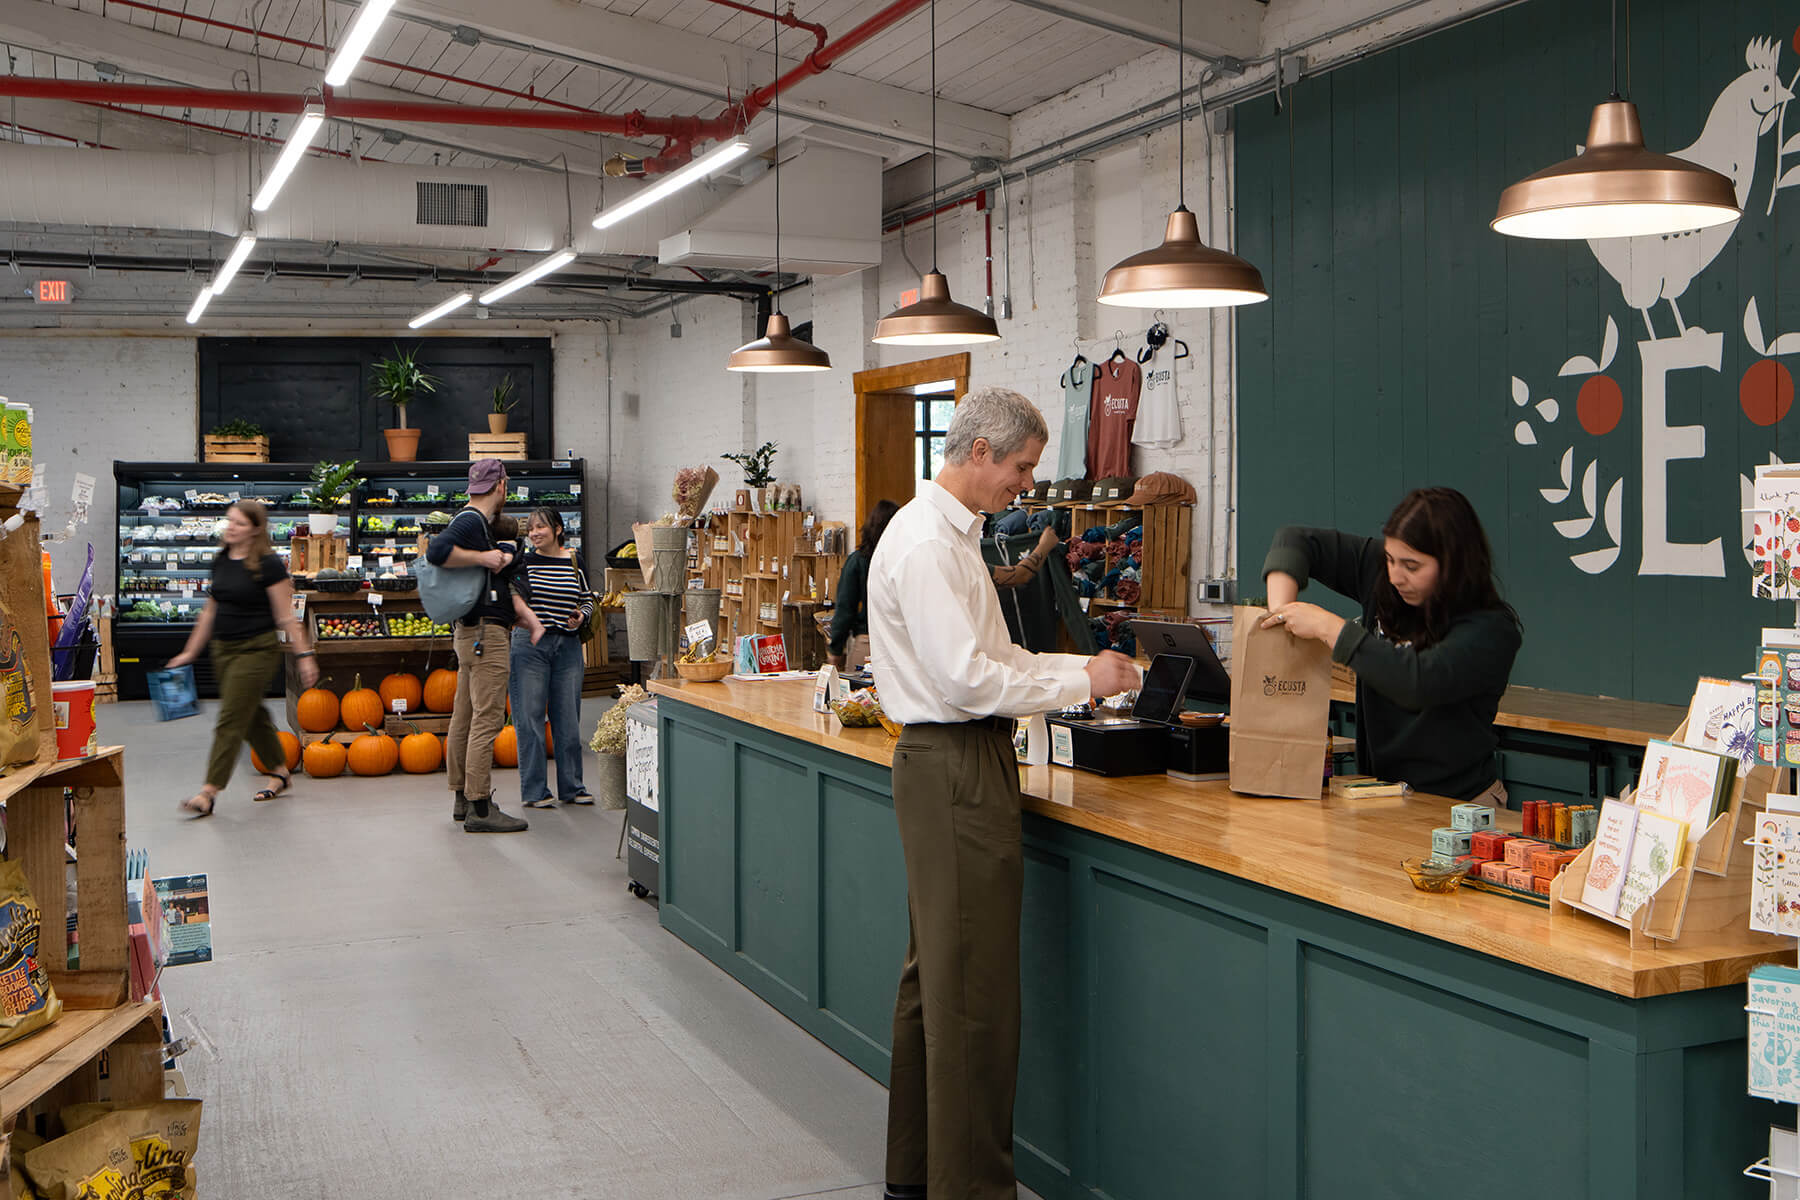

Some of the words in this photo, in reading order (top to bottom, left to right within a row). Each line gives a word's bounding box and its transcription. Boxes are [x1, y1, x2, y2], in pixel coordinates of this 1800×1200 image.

[40, 280, 66, 301] EXIT
[1111, 398, 1128, 410] ECUSTA
[1637, 328, 1726, 578] E
[1278, 680, 1306, 692] ECUSTA
[1723, 702, 1745, 720] HAPPY
[5, 995, 37, 1017] CHIPS
